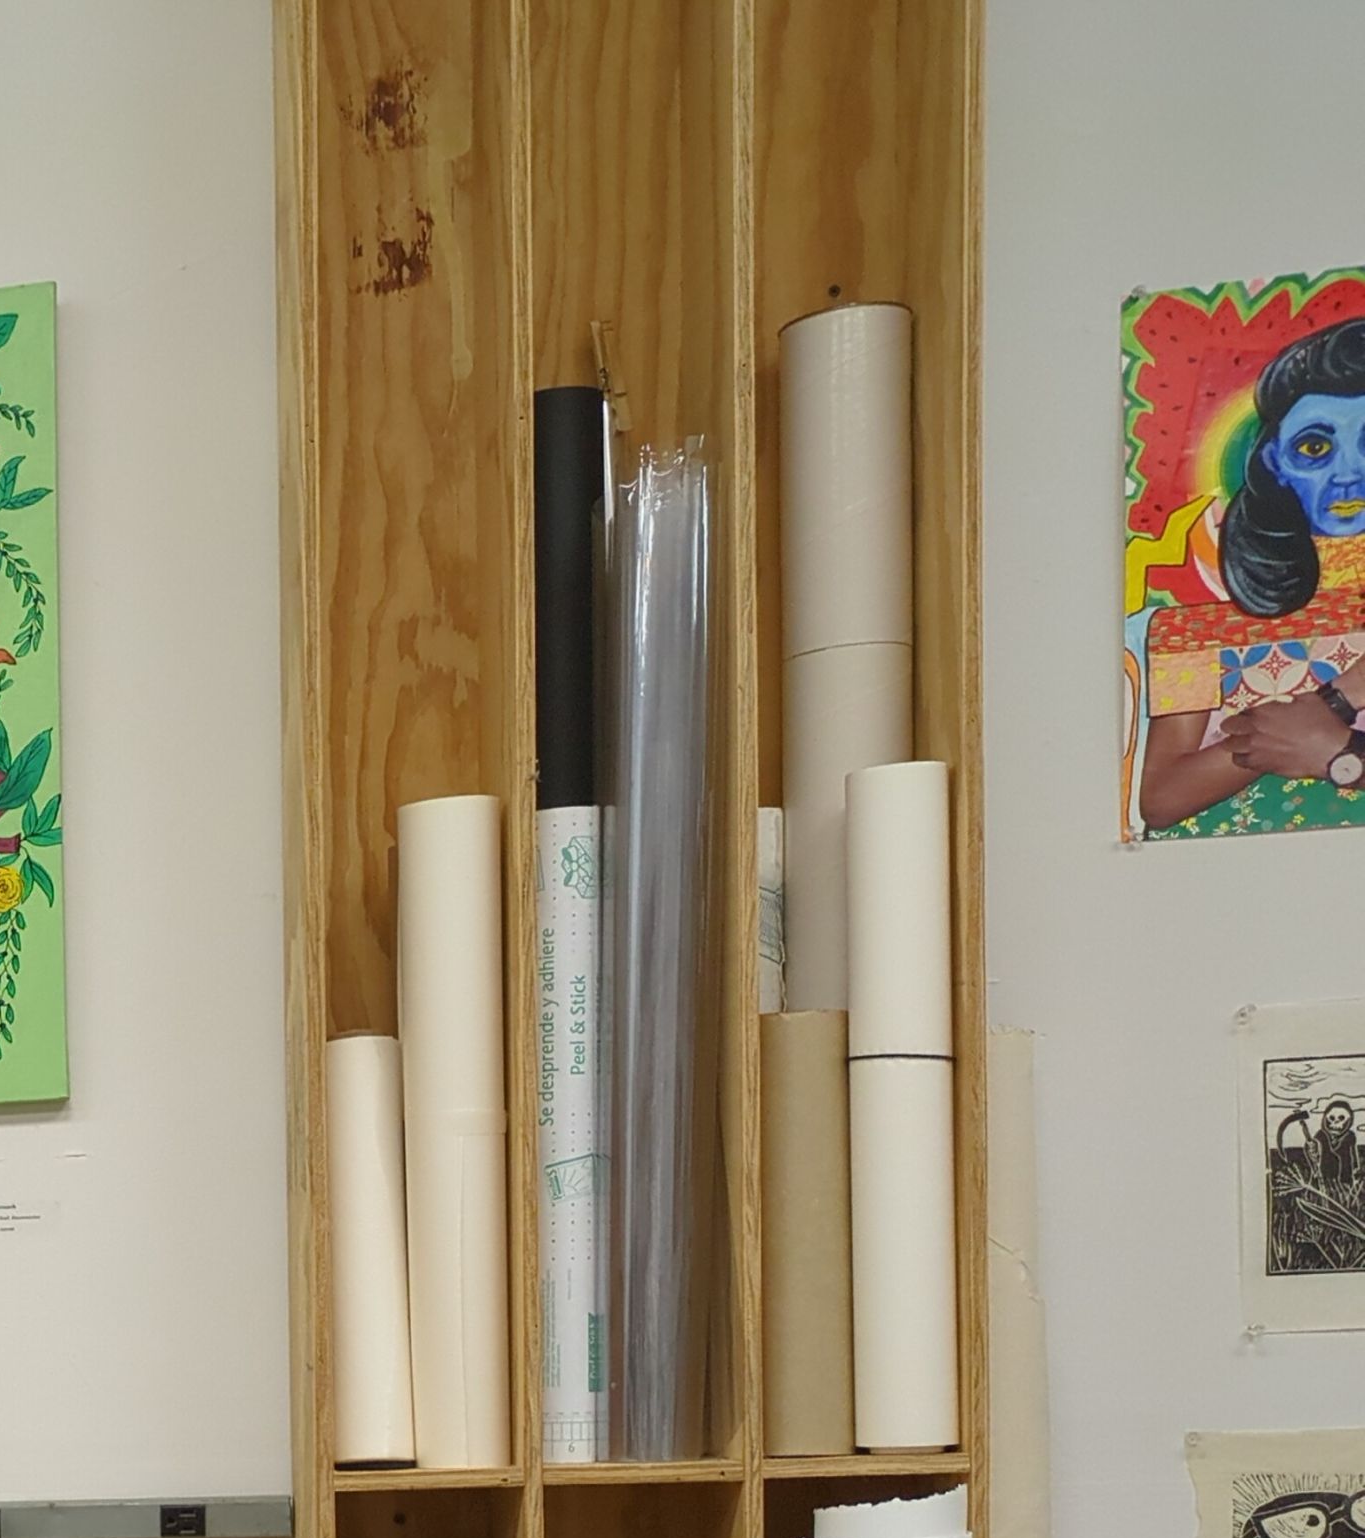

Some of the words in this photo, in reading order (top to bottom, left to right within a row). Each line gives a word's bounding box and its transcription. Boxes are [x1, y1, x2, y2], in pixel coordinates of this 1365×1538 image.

[537, 926, 555, 992] adhiere
[541, 996, 559, 1008] y
[568, 975, 586, 1015] Stick
[569, 1020, 586, 1035] &
[537, 1011, 560, 1102] desprende
[569, 1040, 586, 1076] Peel
[538, 1107, 555, 1127] Se
